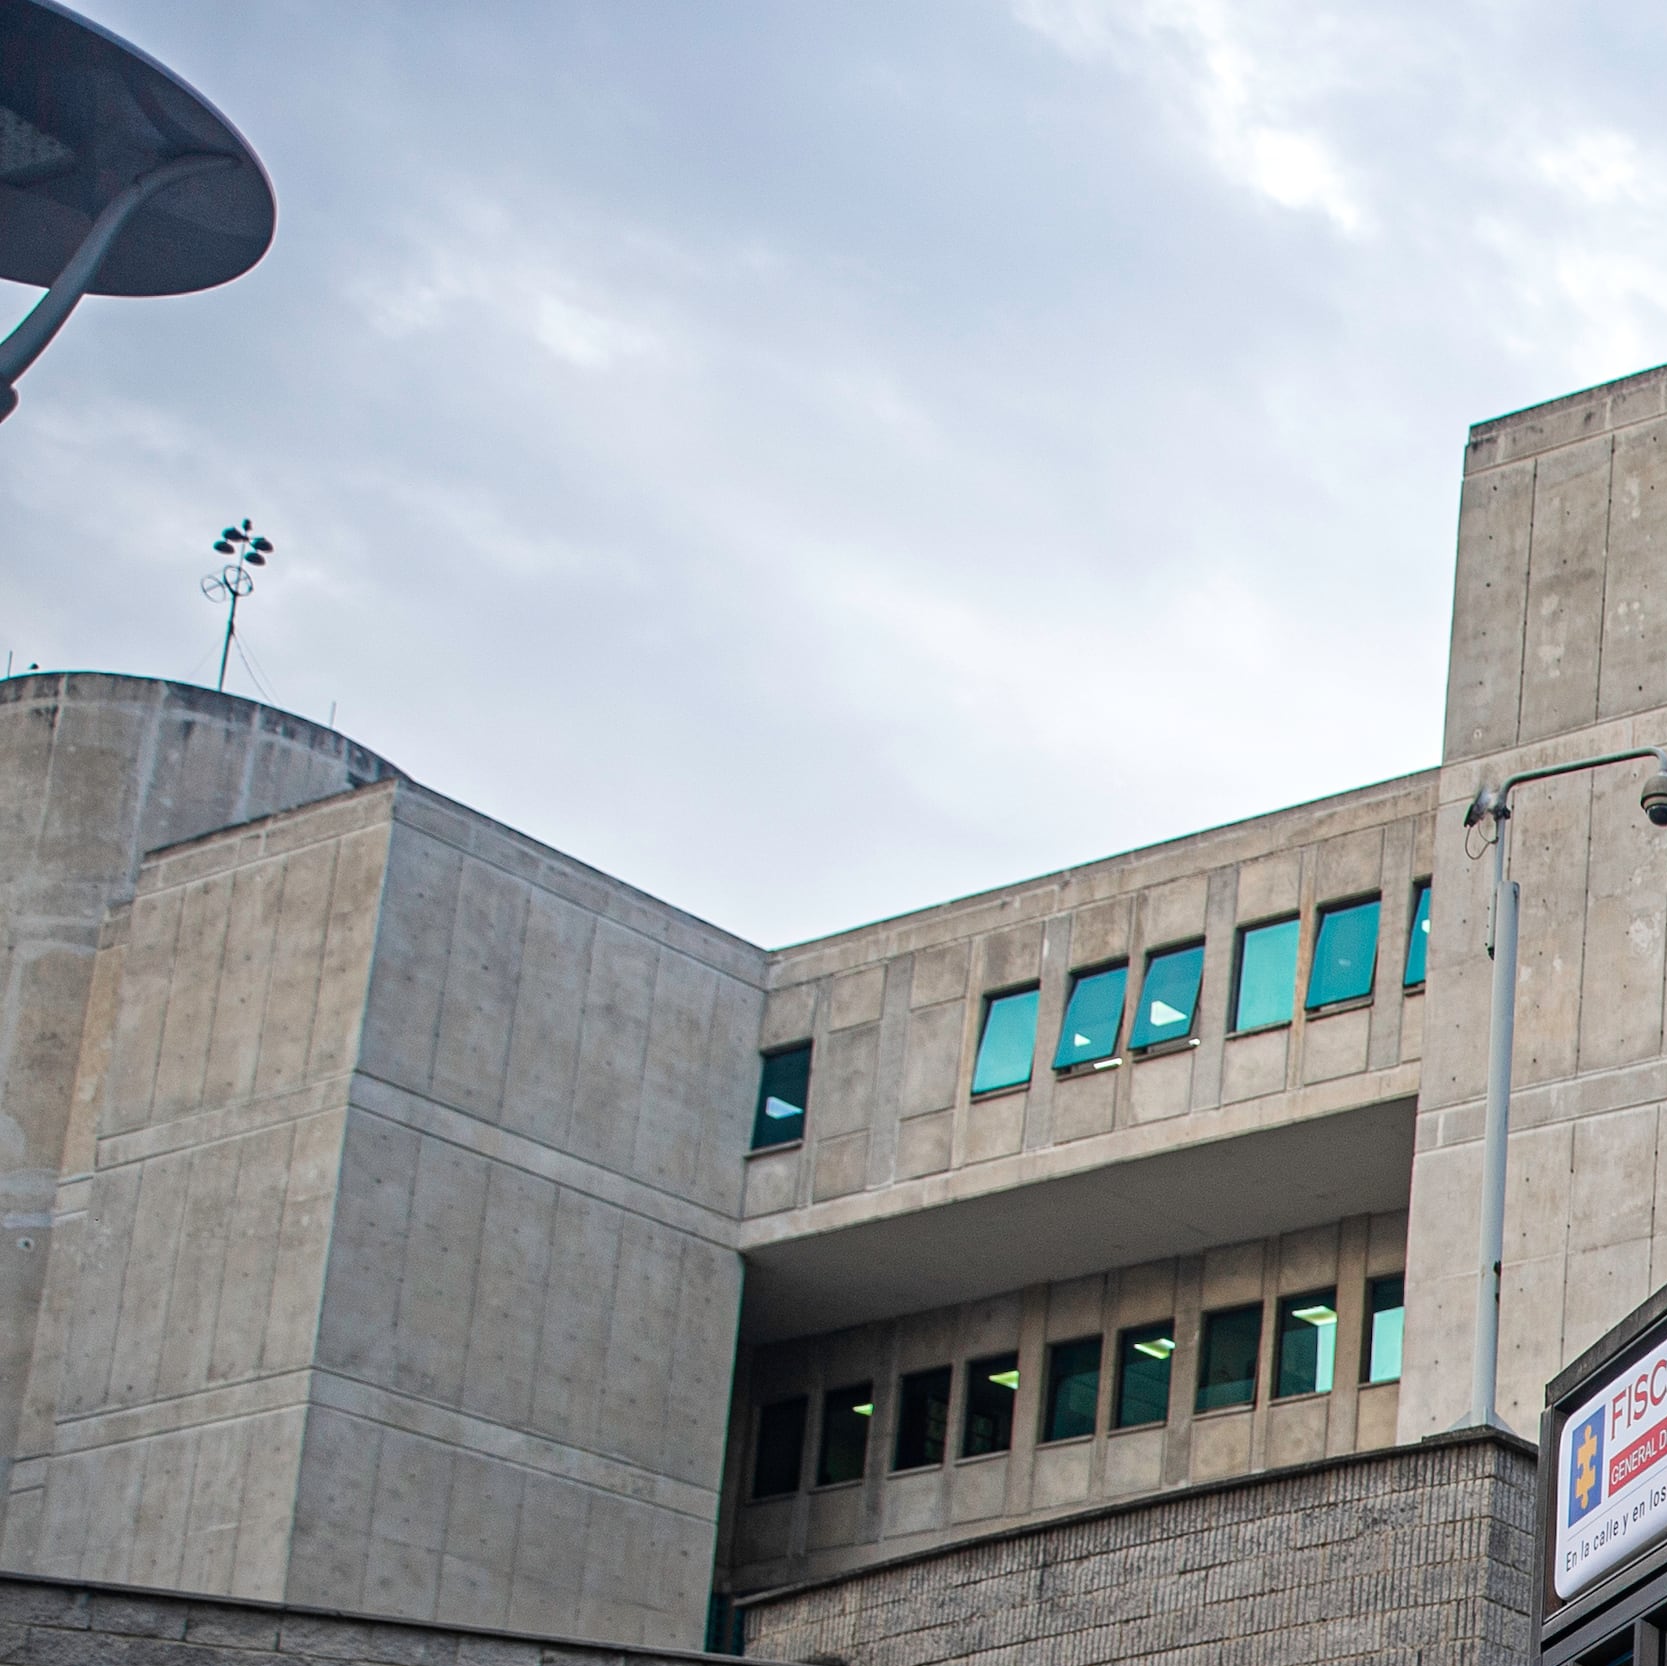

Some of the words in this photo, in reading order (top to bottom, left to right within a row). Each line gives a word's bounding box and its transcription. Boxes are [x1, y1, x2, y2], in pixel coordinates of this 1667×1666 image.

[1611, 1438, 1658, 1486] GENERAL
[1565, 1551, 1578, 1572] En
[1581, 1539, 1590, 1559] la
[1593, 1521, 1618, 1552] calle
[1622, 1514, 1629, 1536] y
[1632, 1499, 1646, 1523] en
[1649, 1485, 1667, 1512] los
